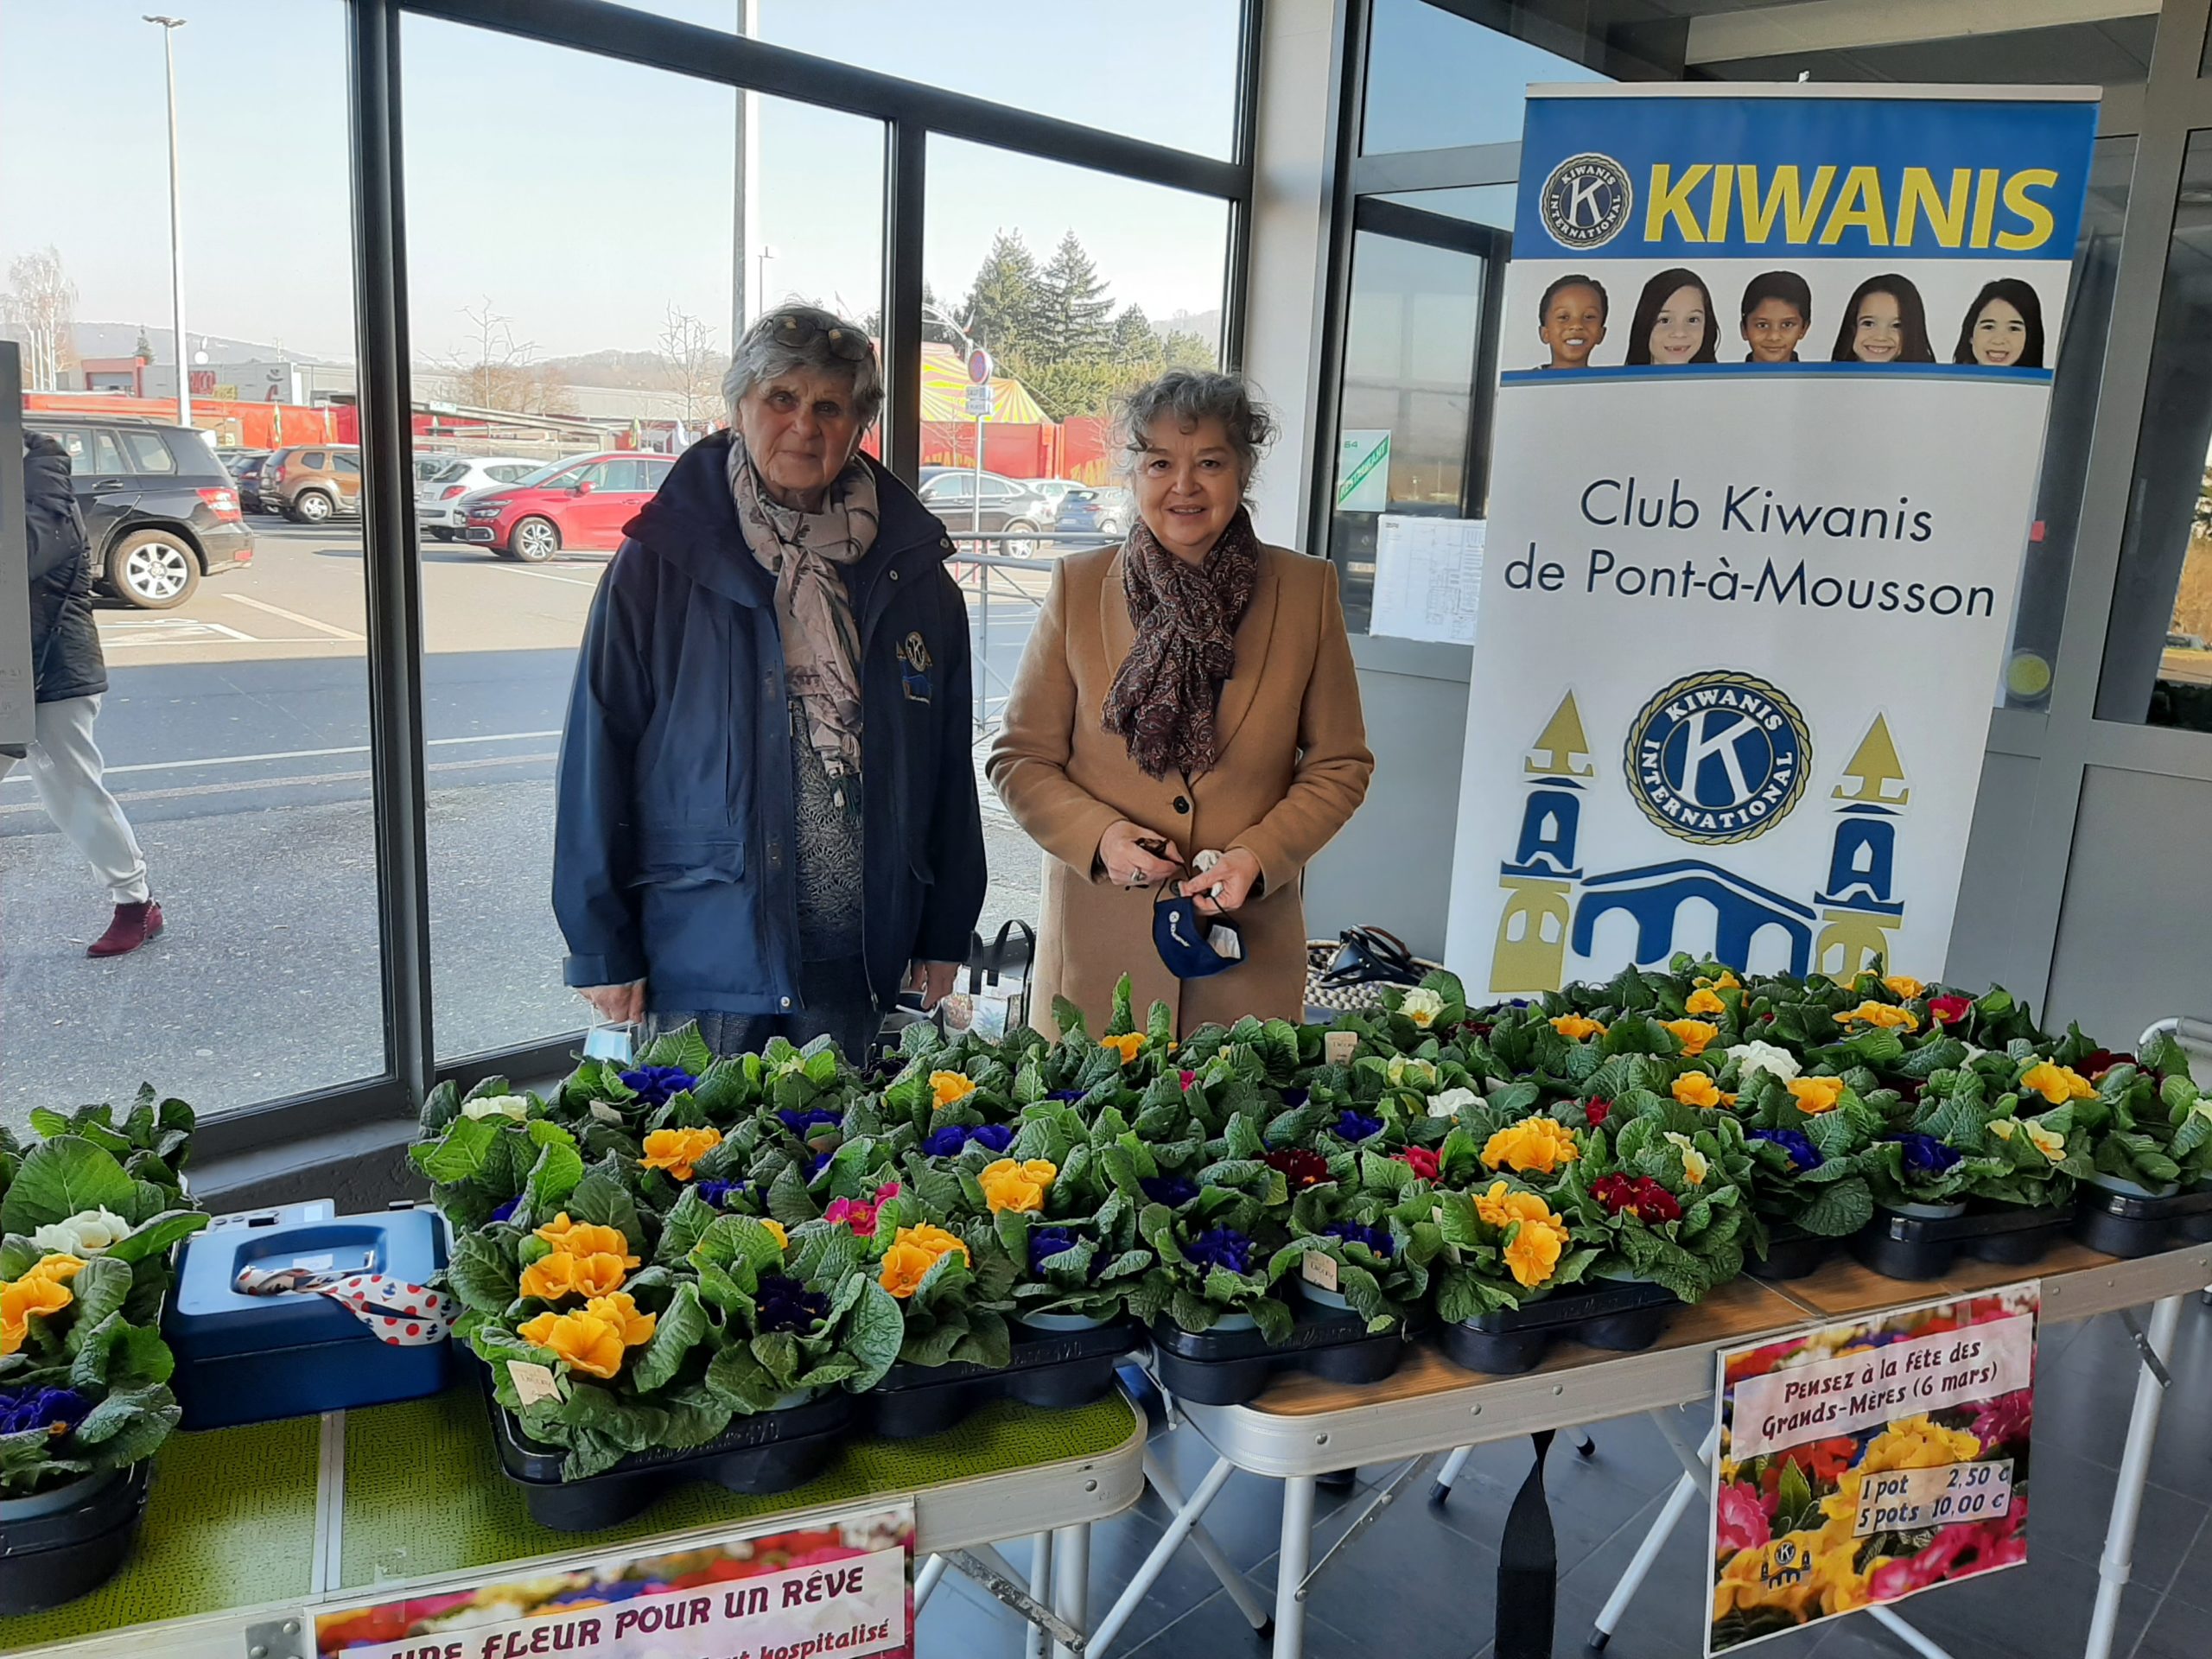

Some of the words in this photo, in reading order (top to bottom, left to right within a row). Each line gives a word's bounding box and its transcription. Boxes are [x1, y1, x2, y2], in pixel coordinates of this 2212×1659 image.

[1560, 165, 1617, 185] KIWANIS
[1567, 176, 1605, 226] K
[1643, 163, 2058, 251] KIWANIS
[1550, 194, 1622, 238] INTERNATIONAL
[1579, 477, 1700, 530] Club
[1720, 484, 1933, 543] Kiwanis
[1503, 542, 1566, 592] de
[1586, 549, 1995, 617] Pont-à-Mousson
[1664, 689, 1783, 731] KIWANIS
[1641, 739, 1794, 830] INTERNATIONAL
[1677, 710, 1759, 808] K
[1761, 1385, 1907, 1440] Grands-Mères
[1913, 1375, 1934, 1398] (6
[1941, 1361, 1998, 1393] mars)
[1783, 1370, 1855, 1404] Pensez
[1861, 1363, 1873, 1384] à
[1879, 1358, 1897, 1380] la
[1949, 1341, 1981, 1363] des
[1858, 1507, 1871, 1528] 5
[1872, 1502, 1920, 1531] pots
[1931, 1493, 1986, 1518] 10,00
[1992, 1492, 2005, 1509] €
[1874, 1474, 1910, 1504] pot
[1946, 1466, 1991, 1490] 2,50
[391, 1643, 463, 1659] NE
[614, 1597, 711, 1641] POUR
[781, 1566, 865, 1609] RÊVE
